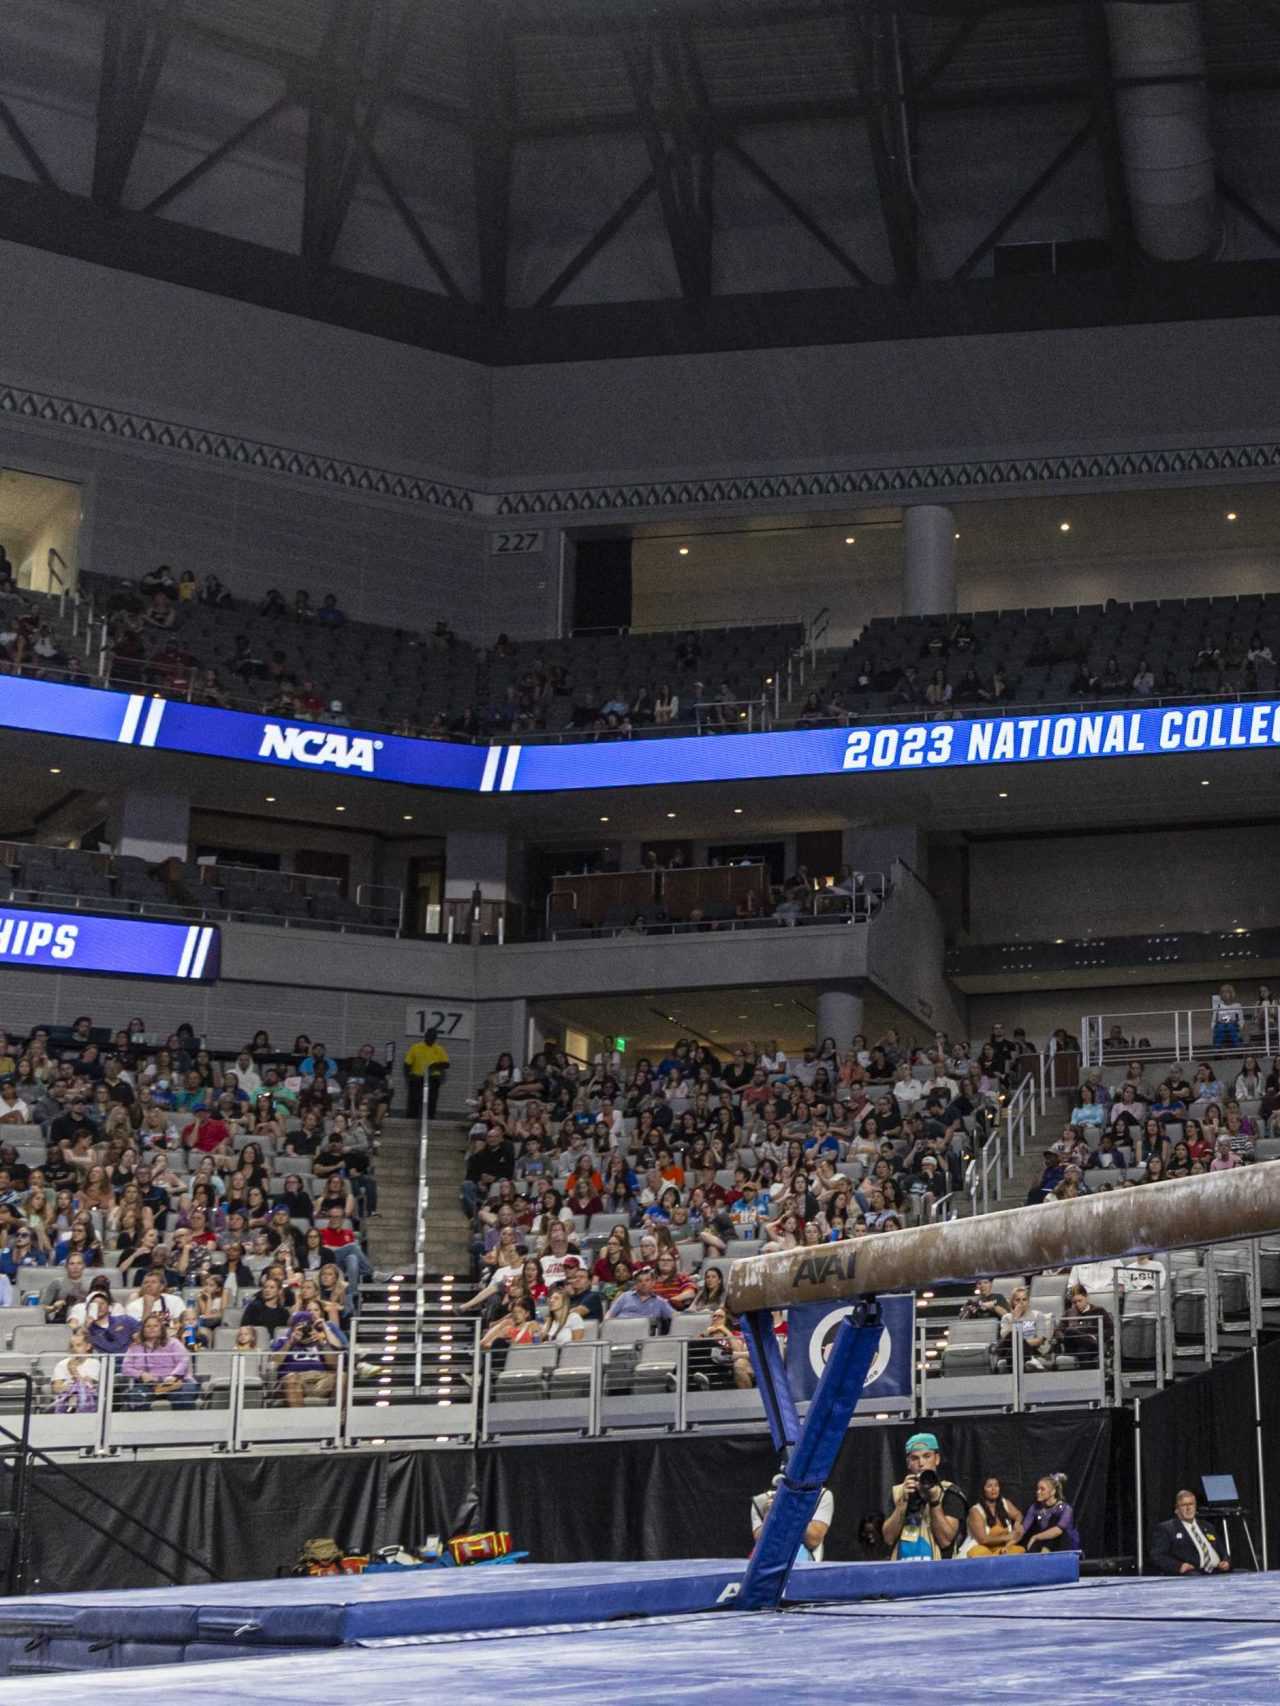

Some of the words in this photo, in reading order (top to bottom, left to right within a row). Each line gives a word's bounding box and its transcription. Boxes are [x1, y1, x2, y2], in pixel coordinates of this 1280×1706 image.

[498, 533, 539, 552] 227
[843, 727, 955, 769] 2023
[967, 716, 1146, 761] NATIONAL
[416, 1010, 463, 1034] 127
